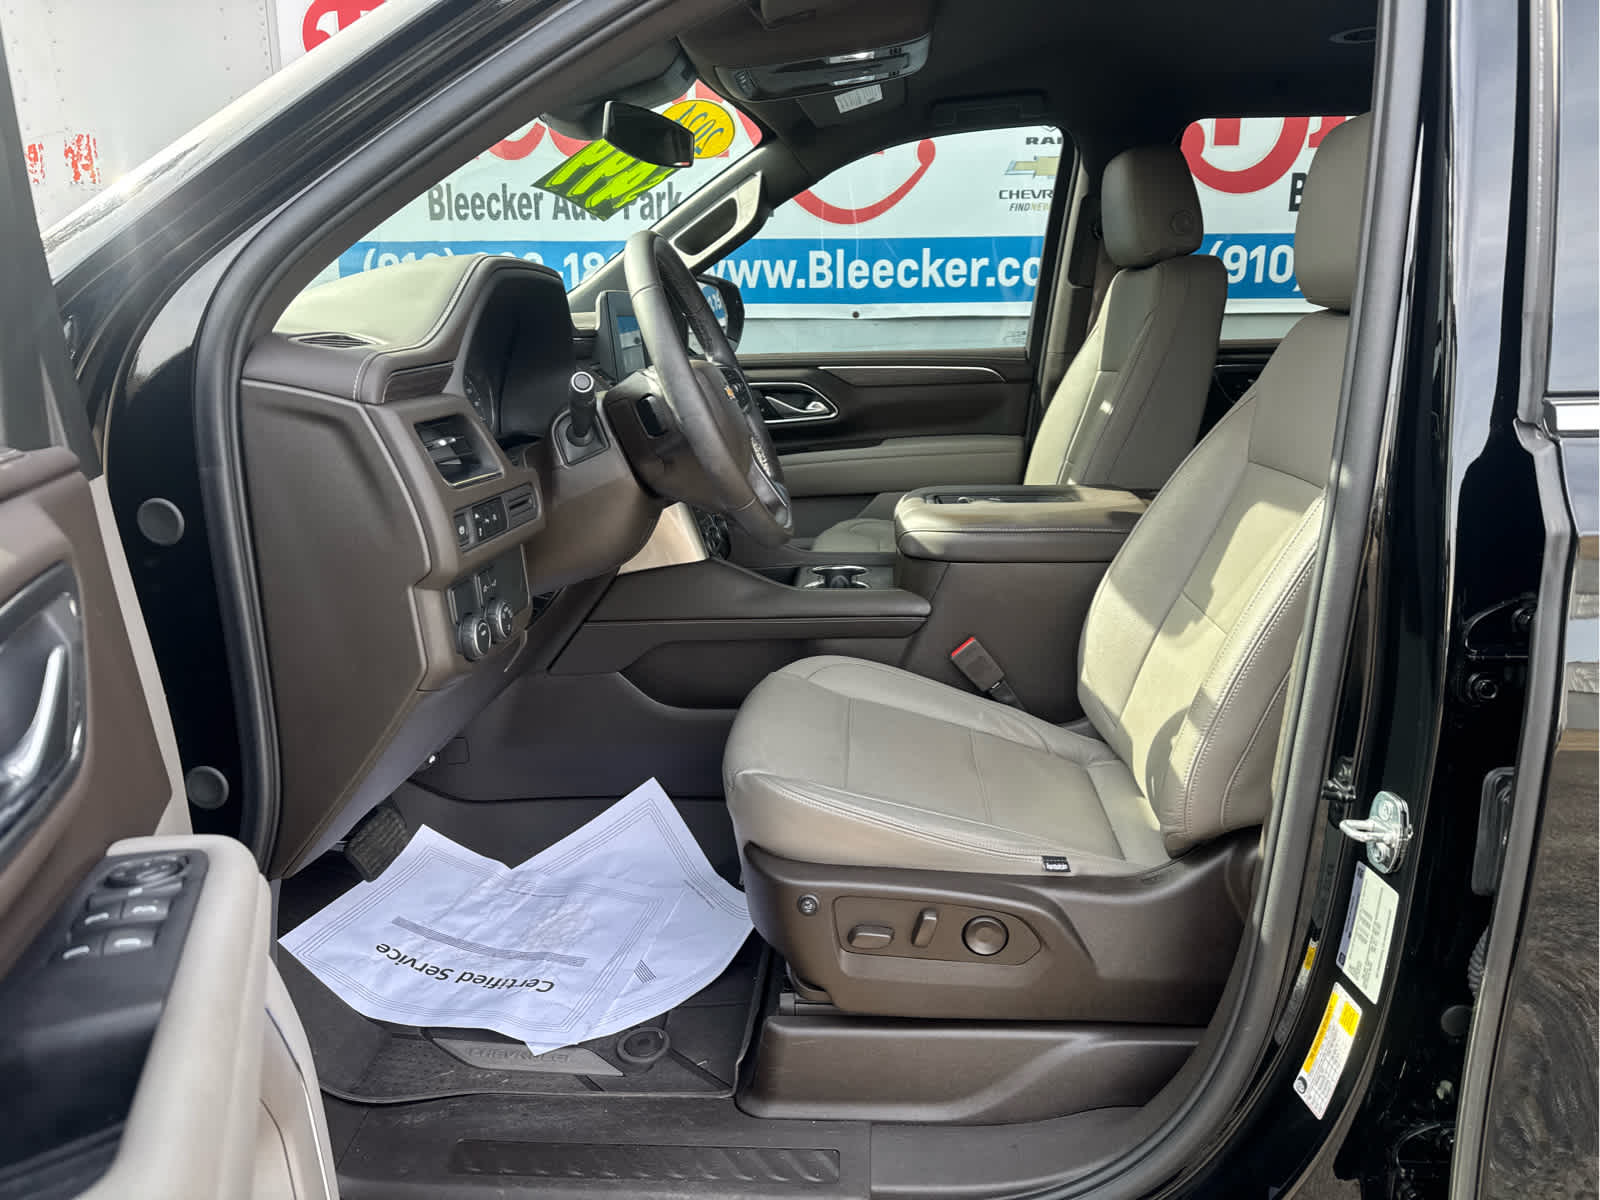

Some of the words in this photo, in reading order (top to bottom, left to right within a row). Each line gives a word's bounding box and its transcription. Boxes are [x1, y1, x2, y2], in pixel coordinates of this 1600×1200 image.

[1026, 136, 1063, 145] RA
[428, 183, 543, 221] Bleecker
[1209, 240, 1301, 292] 910
[376, 943, 455, 981] Service
[455, 971, 555, 993] Certified
